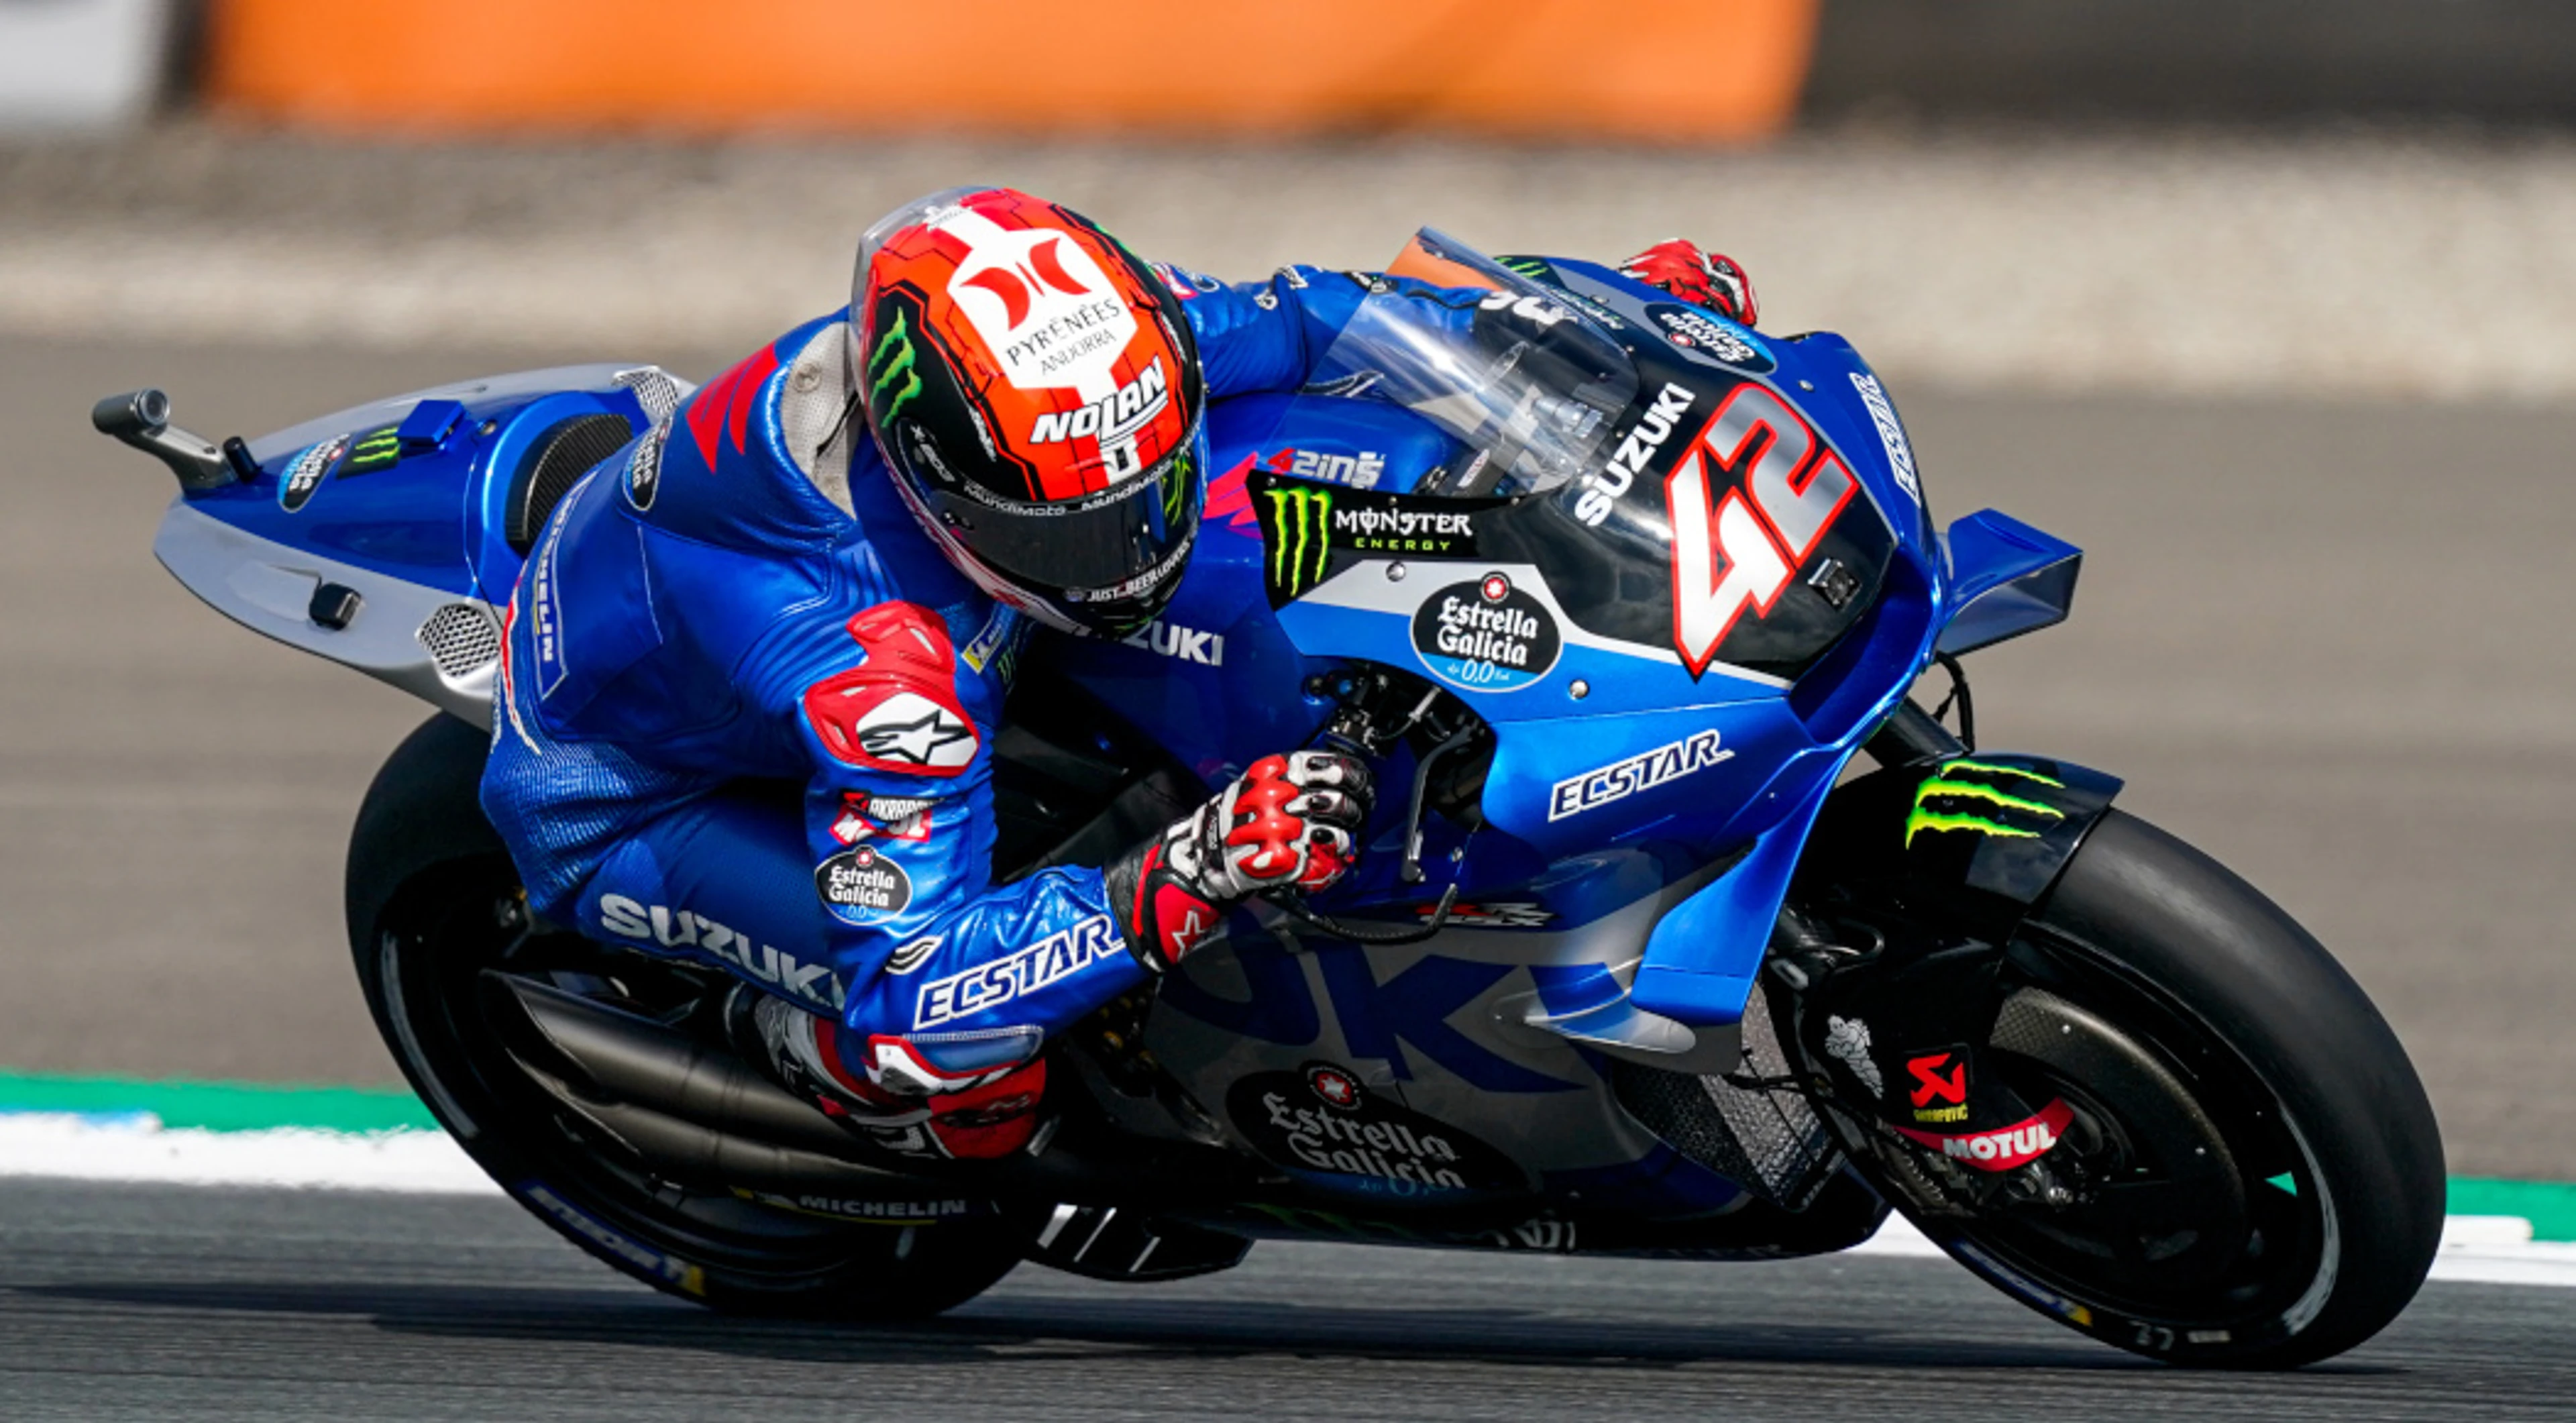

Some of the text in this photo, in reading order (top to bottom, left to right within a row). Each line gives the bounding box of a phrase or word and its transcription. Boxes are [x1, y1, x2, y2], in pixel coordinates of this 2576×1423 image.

[1040, 329, 1118, 376] ANDORRA
[1028, 352, 1169, 445] NOLAN
[1574, 382, 1696, 527] SUZUKI
[1335, 506, 1474, 537] MONSTER
[1664, 382, 1860, 678] 42
[1354, 538, 1452, 552] ENERGY
[1087, 587, 1119, 602] JUST
[1437, 595, 1539, 639] Estrella
[1437, 623, 1528, 666] Galicia
[1548, 729, 1735, 823] ECSTAR
[828, 865, 896, 890] Estrella
[828, 882, 890, 907] Galicia
[600, 893, 845, 1012] SUZUKI
[913, 913, 1125, 1032] ECSTAR
[1263, 1091, 1460, 1163] Estrella
[1943, 1121, 2057, 1160] MOTUL
[1287, 1131, 1466, 1190] Galicia
[799, 1194, 967, 1217] MICHELIN
